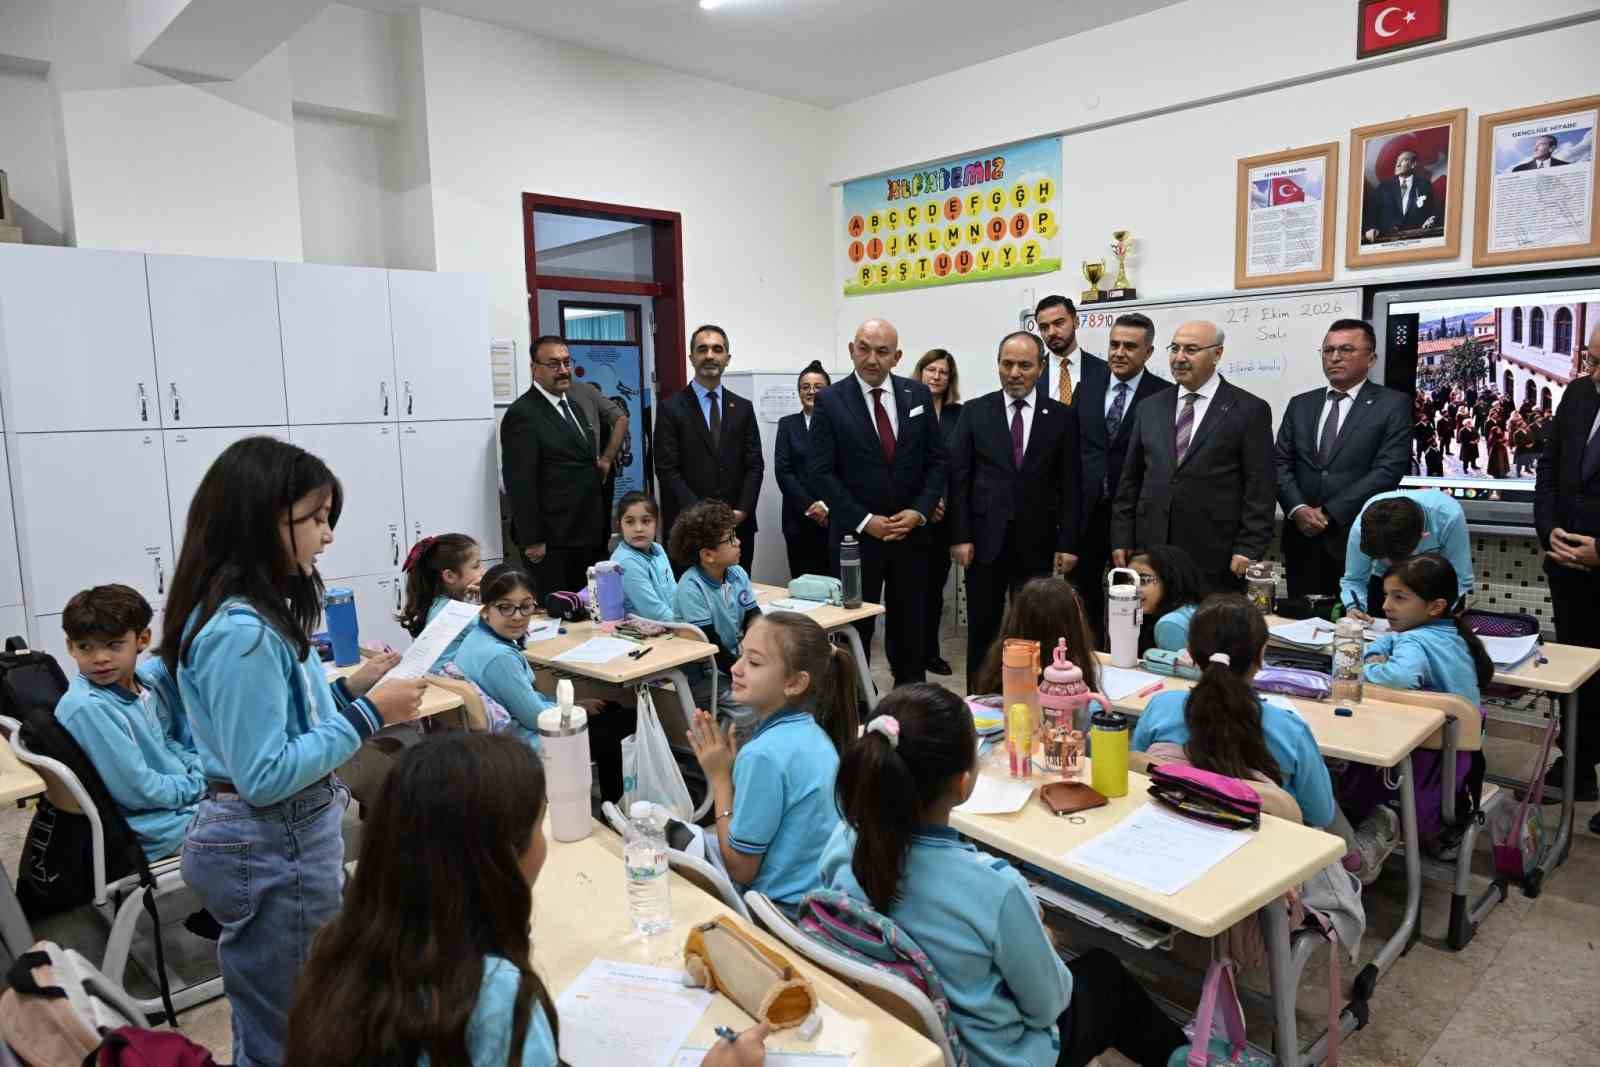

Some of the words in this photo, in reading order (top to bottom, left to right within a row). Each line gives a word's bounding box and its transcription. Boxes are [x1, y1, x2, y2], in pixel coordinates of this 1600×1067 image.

[853, 219, 860, 230] A
[871, 216, 879, 227] B
[889, 212, 897, 223] C
[908, 207, 917, 221] Ç
[928, 205, 937, 216] D
[949, 200, 957, 212] E
[971, 196, 979, 208] F
[992, 192, 1001, 204] G
[1015, 186, 1025, 201] Ğ
[1039, 183, 1049, 196] H
[891, 238, 897, 250] J
[908, 233, 918, 246] K
[929, 232, 937, 243] L
[948, 228, 959, 240] M
[970, 224, 979, 236] N
[992, 221, 1002, 233] O
[1015, 215, 1024, 231] Ö
[1038, 213, 1048, 225] P
[862, 268, 870, 279] R
[880, 266, 888, 277] S
[900, 263, 907, 275] Ş
[918, 259, 927, 271] T
[939, 257, 948, 269] U
[960, 250, 969, 266] Ü
[981, 250, 990, 262] V
[1003, 247, 1011, 259] Y
[1026, 246, 1035, 258] Z
[1226, 307, 1249, 324] 27
[1261, 307, 1290, 322] Ekim
[1301, 302, 1342, 317] 2026
